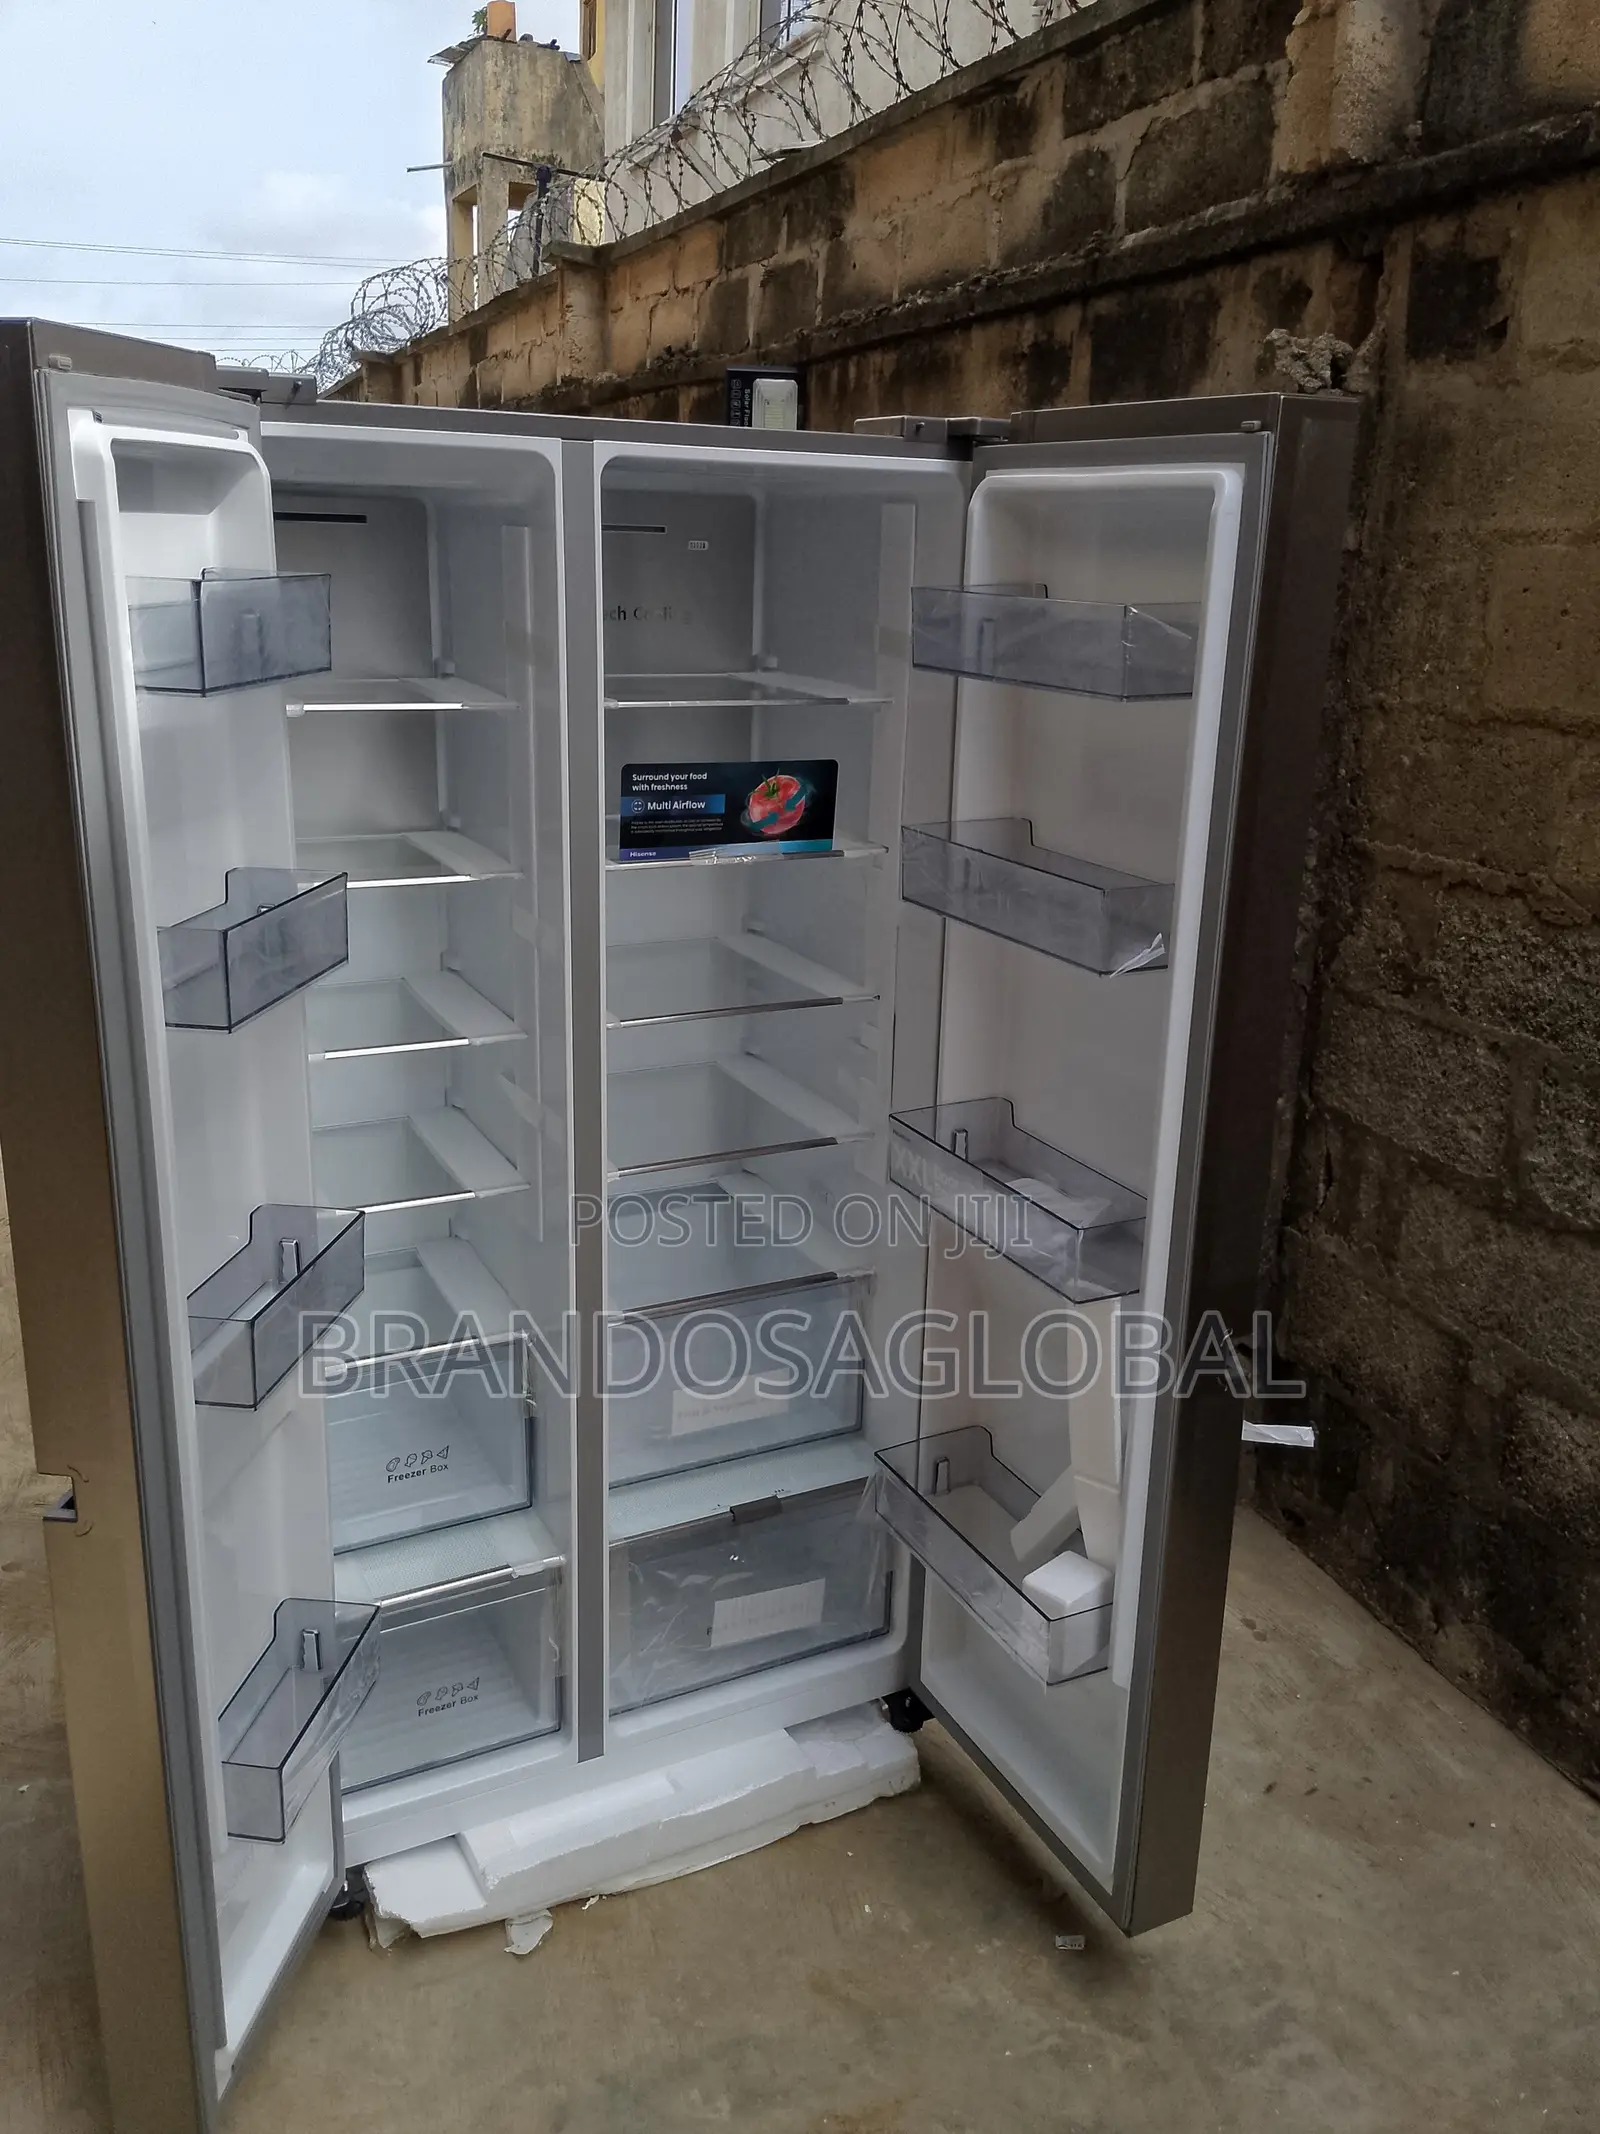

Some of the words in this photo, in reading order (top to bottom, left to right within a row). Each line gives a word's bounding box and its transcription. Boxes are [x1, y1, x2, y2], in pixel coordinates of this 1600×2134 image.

[632, 773, 669, 781] Surround
[670, 774, 688, 782] your
[689, 772, 707, 780] food
[650, 783, 688, 791] freshness
[647, 801, 671, 811] Multi
[672, 800, 706, 810] Airflow
[387, 1467, 427, 1483] Freezer
[429, 1462, 449, 1474] Box
[418, 1699, 456, 1717] Freezer
[460, 1694, 479, 1706] Box
